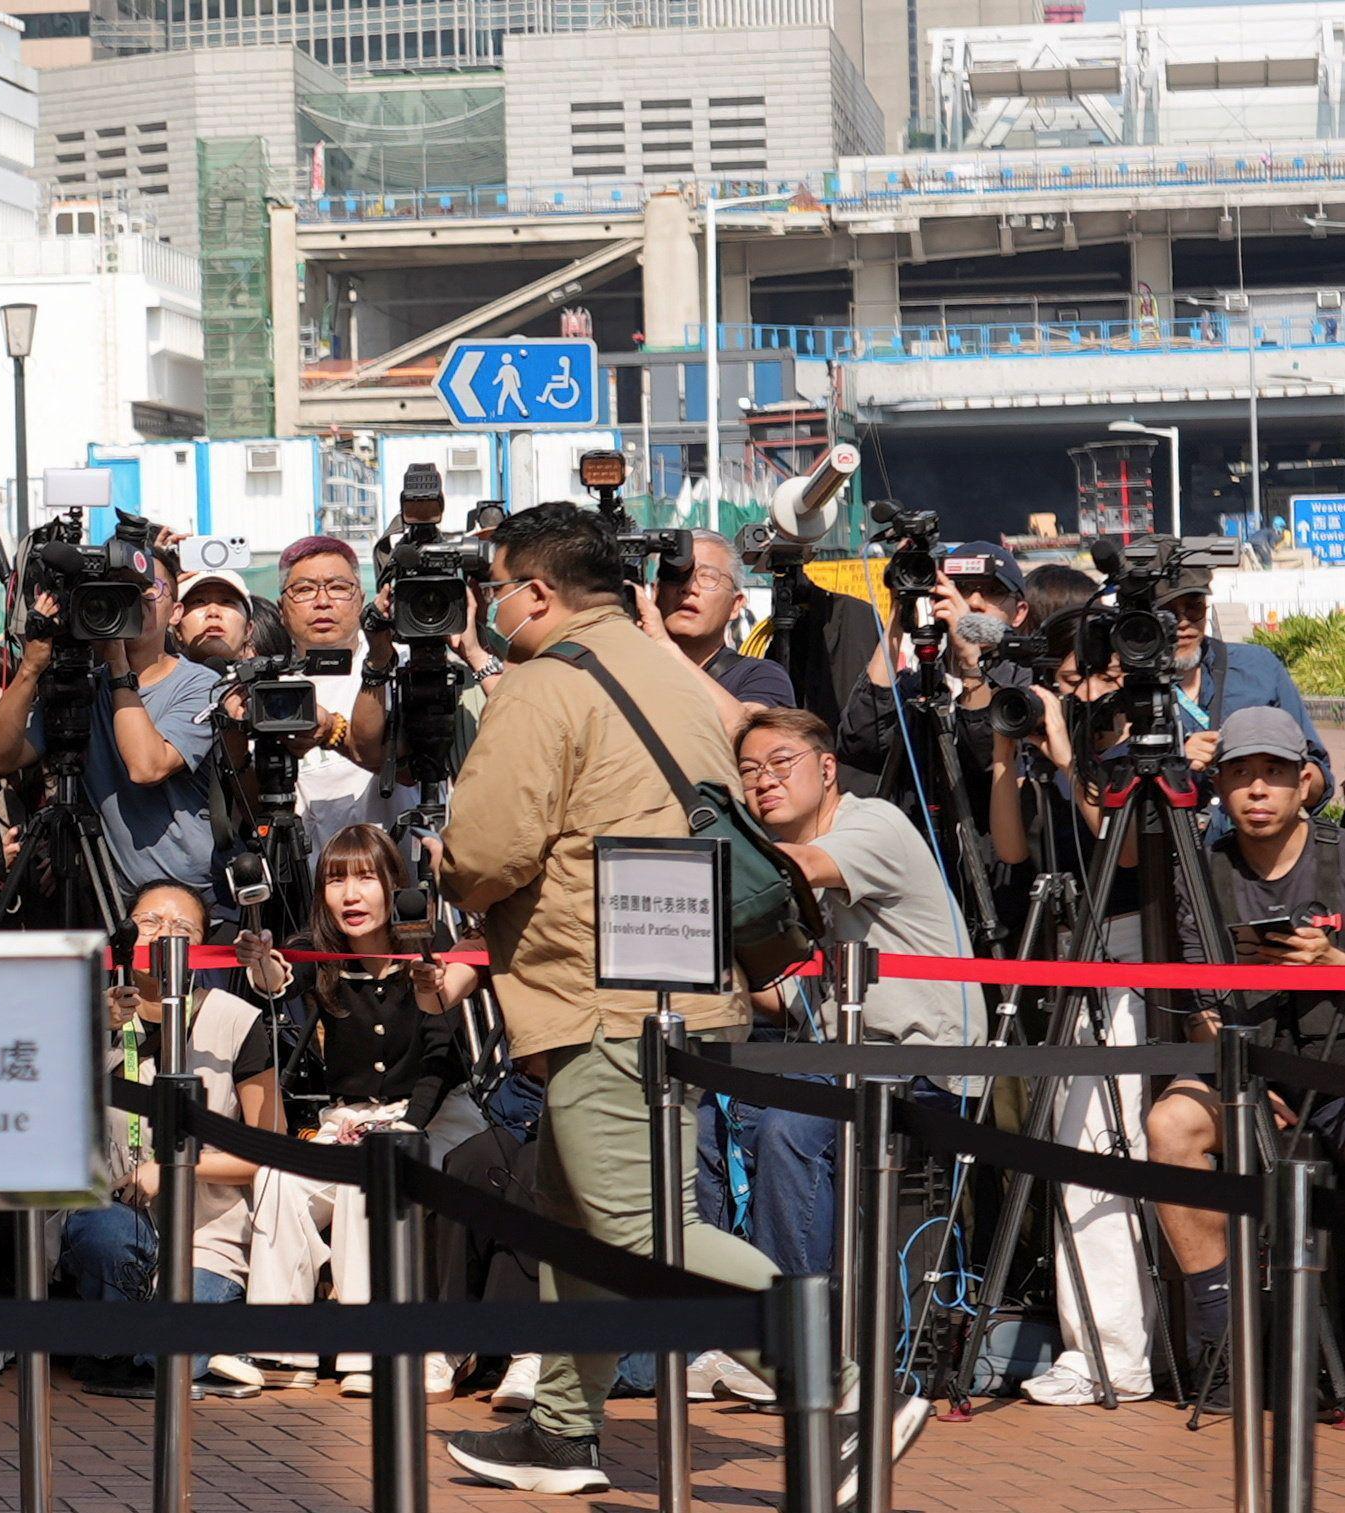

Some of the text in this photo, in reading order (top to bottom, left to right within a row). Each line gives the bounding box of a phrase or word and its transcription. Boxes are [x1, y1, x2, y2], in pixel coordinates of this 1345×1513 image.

[1314, 543, 1345, 558] 九龍
[609, 922, 645, 935] Involved
[648, 923, 679, 937] Parties
[682, 925, 711, 940] Queue
